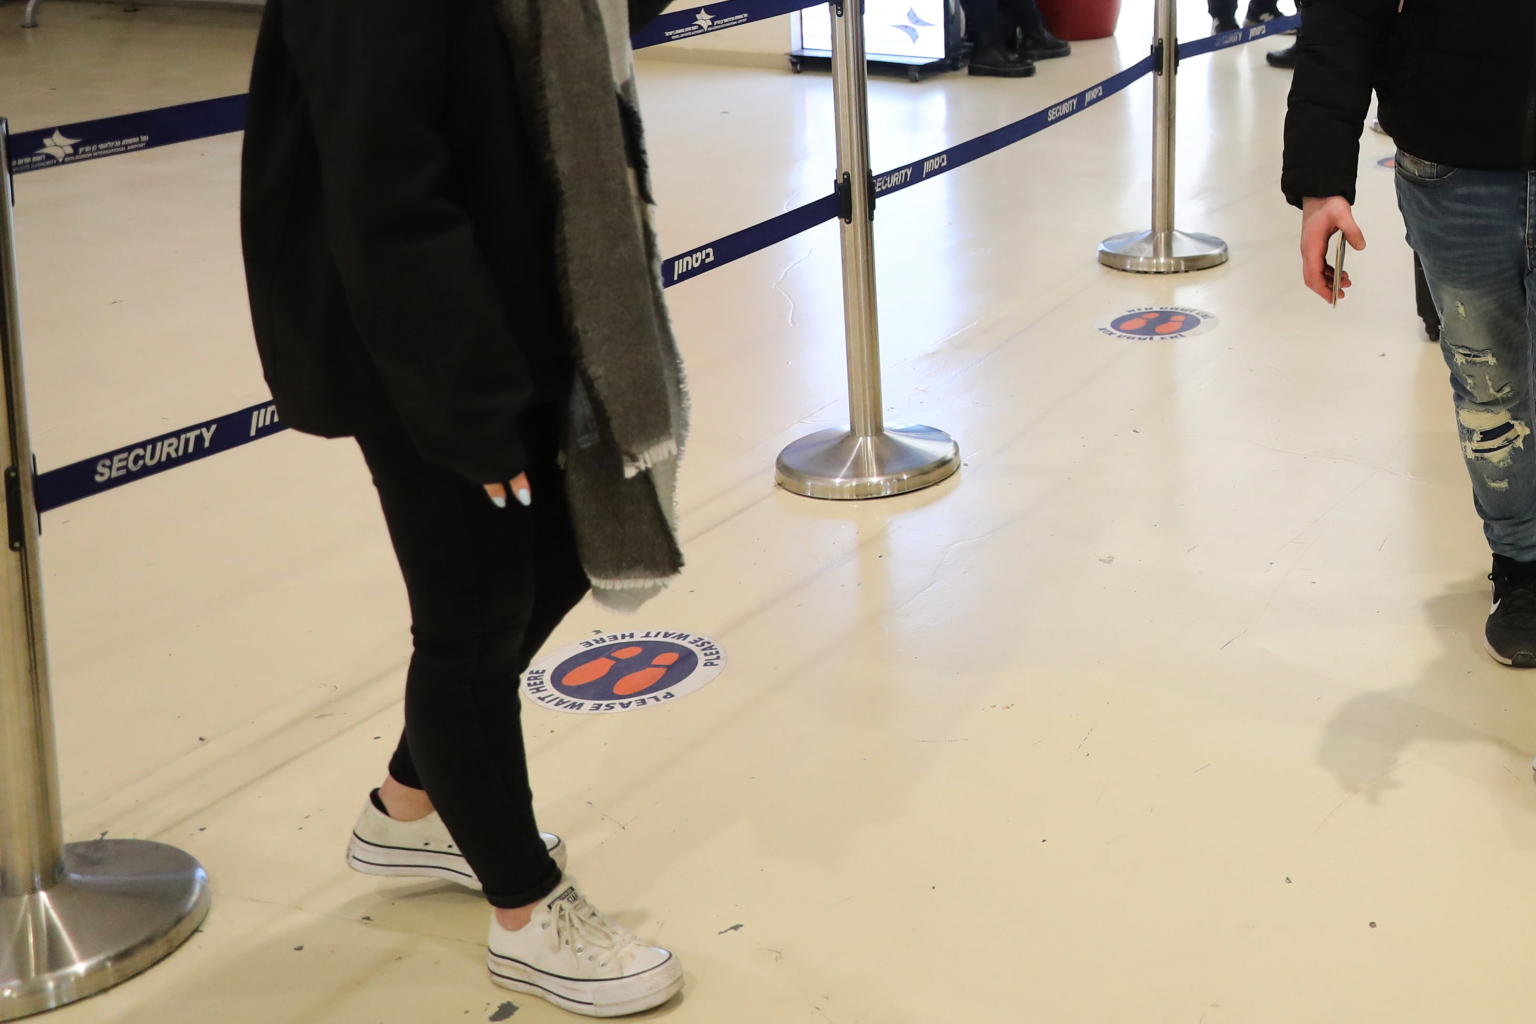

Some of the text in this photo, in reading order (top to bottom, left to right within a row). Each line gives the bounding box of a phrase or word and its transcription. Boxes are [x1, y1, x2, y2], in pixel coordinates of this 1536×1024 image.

[1047, 97, 1078, 122] SECURITY
[922, 154, 947, 178] ביטחון
[673, 247, 715, 281] ביטחון
[94, 424, 217, 483] SECURITY
[579, 631, 721, 667] PLEASE WAIT HERE
[527, 669, 675, 713] PLEASE WAIT HERE
